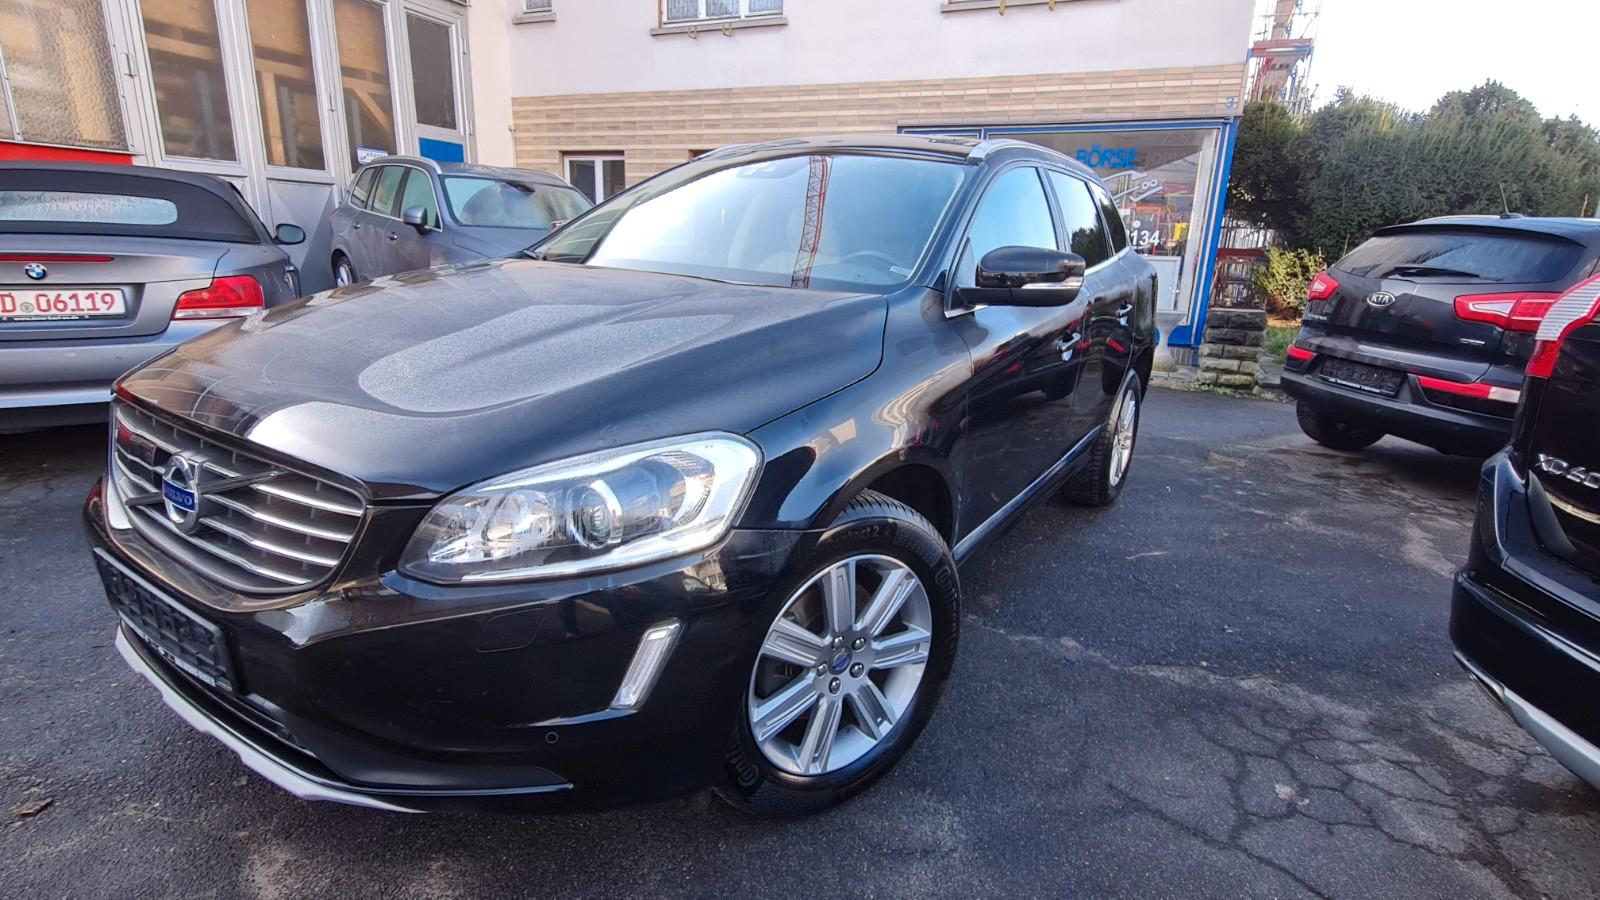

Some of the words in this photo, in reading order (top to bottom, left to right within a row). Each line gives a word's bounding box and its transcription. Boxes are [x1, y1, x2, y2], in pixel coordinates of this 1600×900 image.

[1225, 96, 1235, 109] 3
[1076, 144, 1137, 169] BÖRSE
[35, 293, 115, 312] 06119
[1537, 453, 1600, 489] XC60
